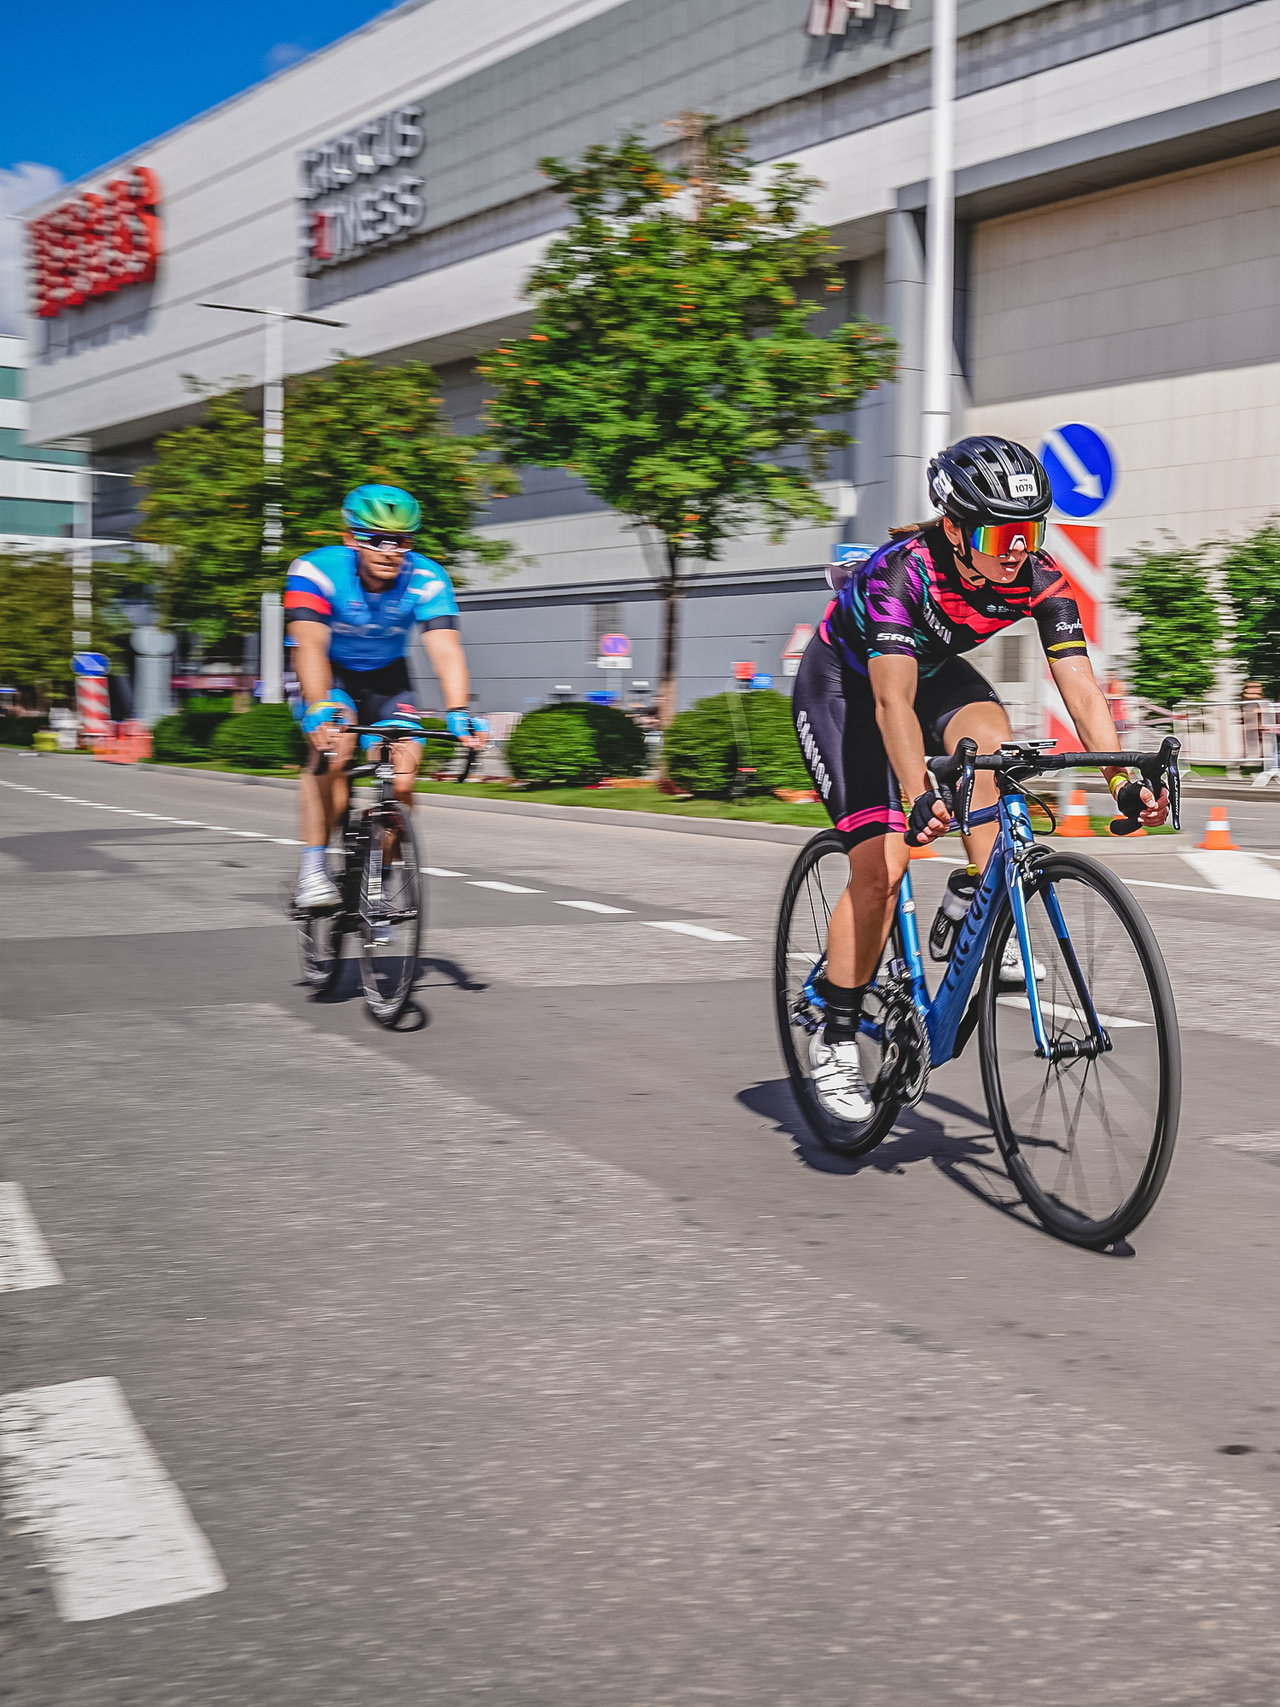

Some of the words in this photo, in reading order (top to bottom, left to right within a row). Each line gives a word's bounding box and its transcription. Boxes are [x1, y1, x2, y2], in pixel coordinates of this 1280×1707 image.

[1014, 483, 1034, 493] 1079
[1055, 618, 1083, 634] Raph
[876, 632, 917, 648] SRA
